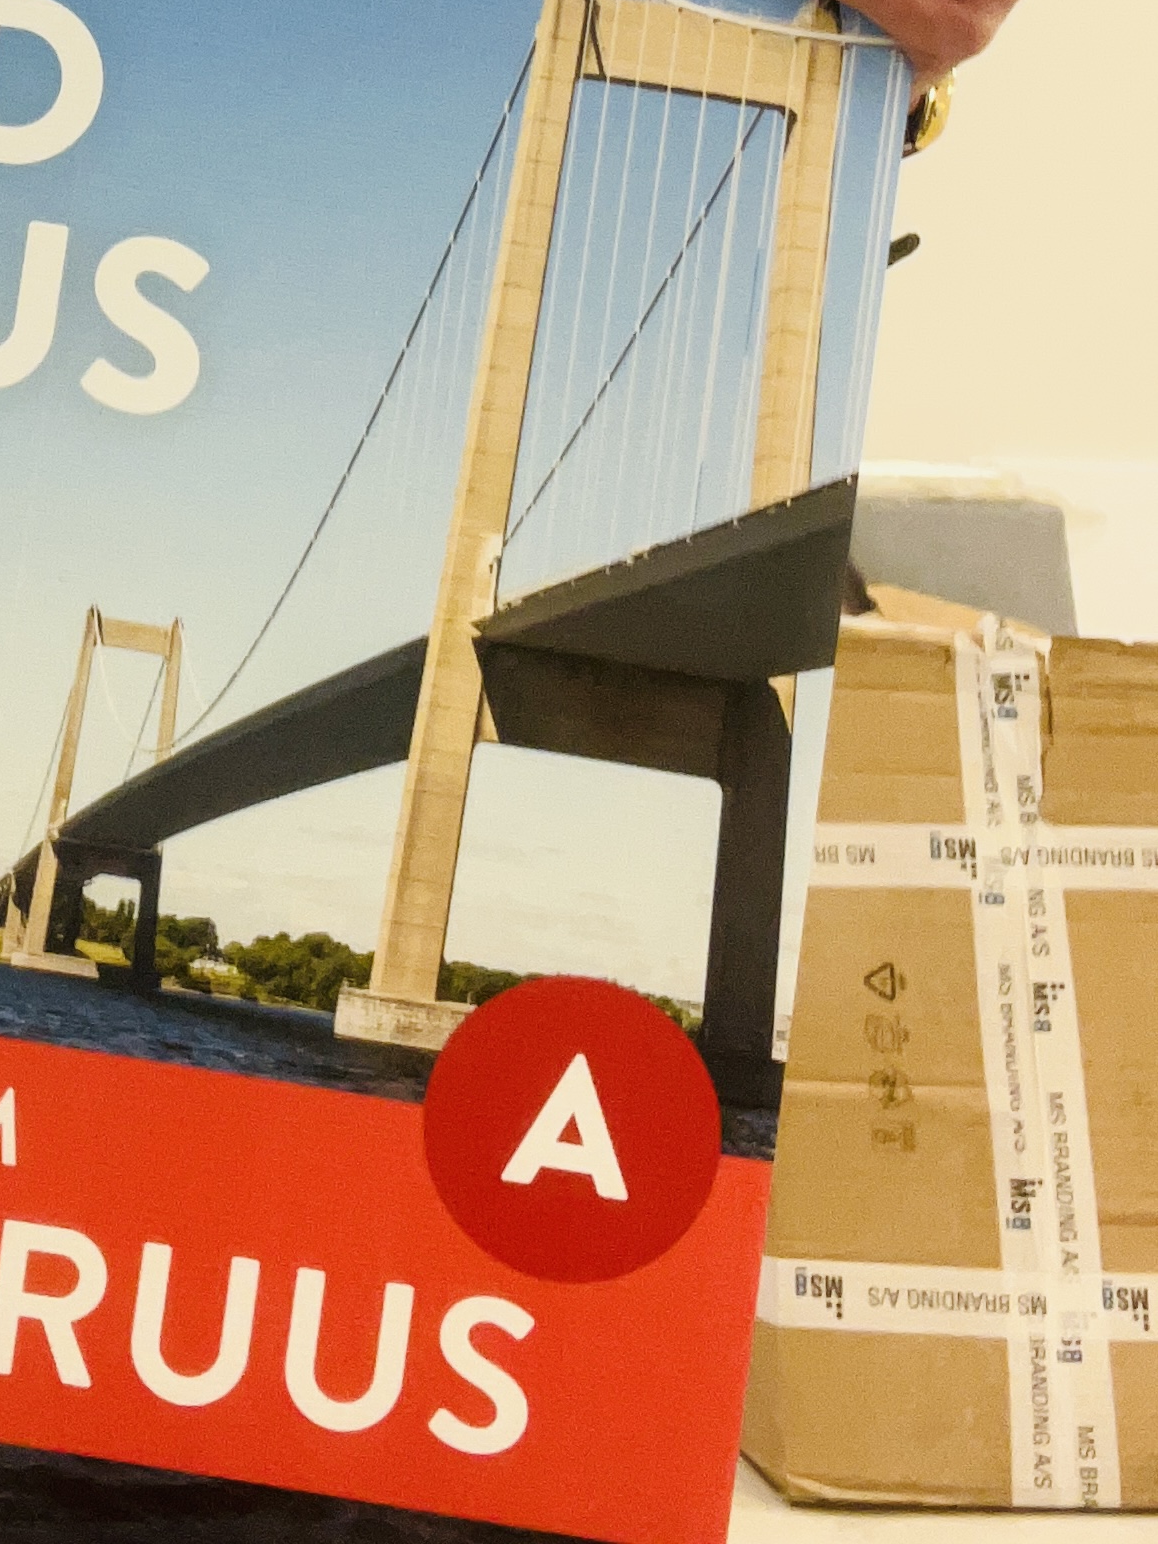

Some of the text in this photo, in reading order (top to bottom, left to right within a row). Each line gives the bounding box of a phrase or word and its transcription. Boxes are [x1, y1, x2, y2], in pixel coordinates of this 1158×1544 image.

[501, 1054, 628, 1200] A
[796, 1268, 843, 1302] MSB
[868, 1286, 900, 1308] A/S
[908, 1288, 1011, 1316] BRANDING
[1102, 1284, 1150, 1314] MSB
[1078, 1425, 1097, 1460] MS
[1033, 1451, 1053, 1490] A/S
